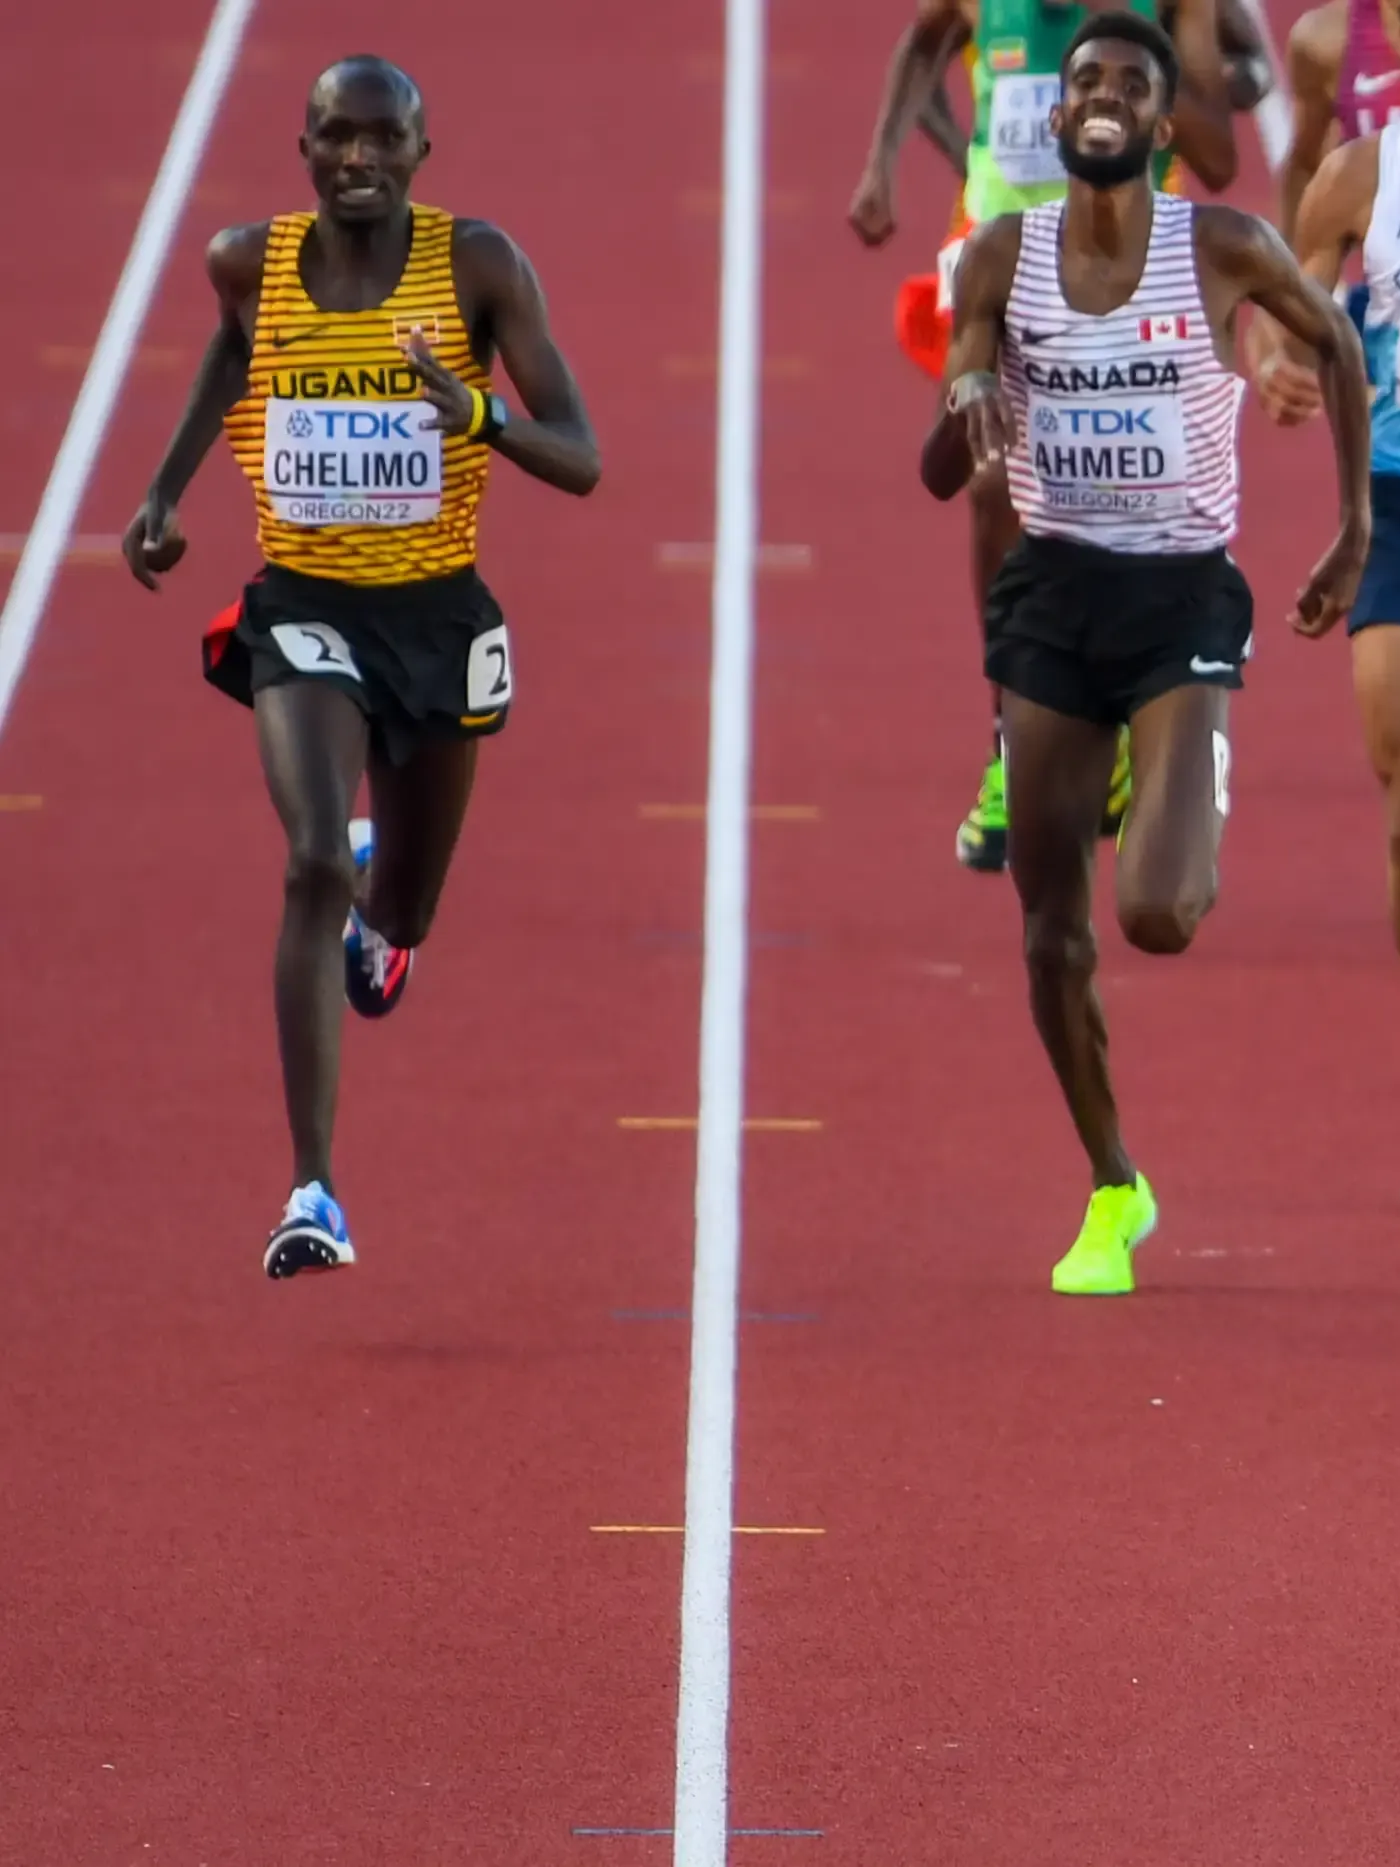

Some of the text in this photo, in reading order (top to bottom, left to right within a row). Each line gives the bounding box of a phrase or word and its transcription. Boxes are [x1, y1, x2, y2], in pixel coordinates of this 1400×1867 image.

[271, 368, 418, 399] UGAND
[1024, 360, 1181, 393] CANADA
[314, 410, 412, 439] TDK
[1060, 407, 1155, 434] TDK
[273, 450, 428, 488] CHELIMO
[1034, 442, 1165, 480] AHMED
[288, 502, 411, 521] OREGON22
[300, 628, 343, 663] 2
[485, 643, 509, 696] 2
